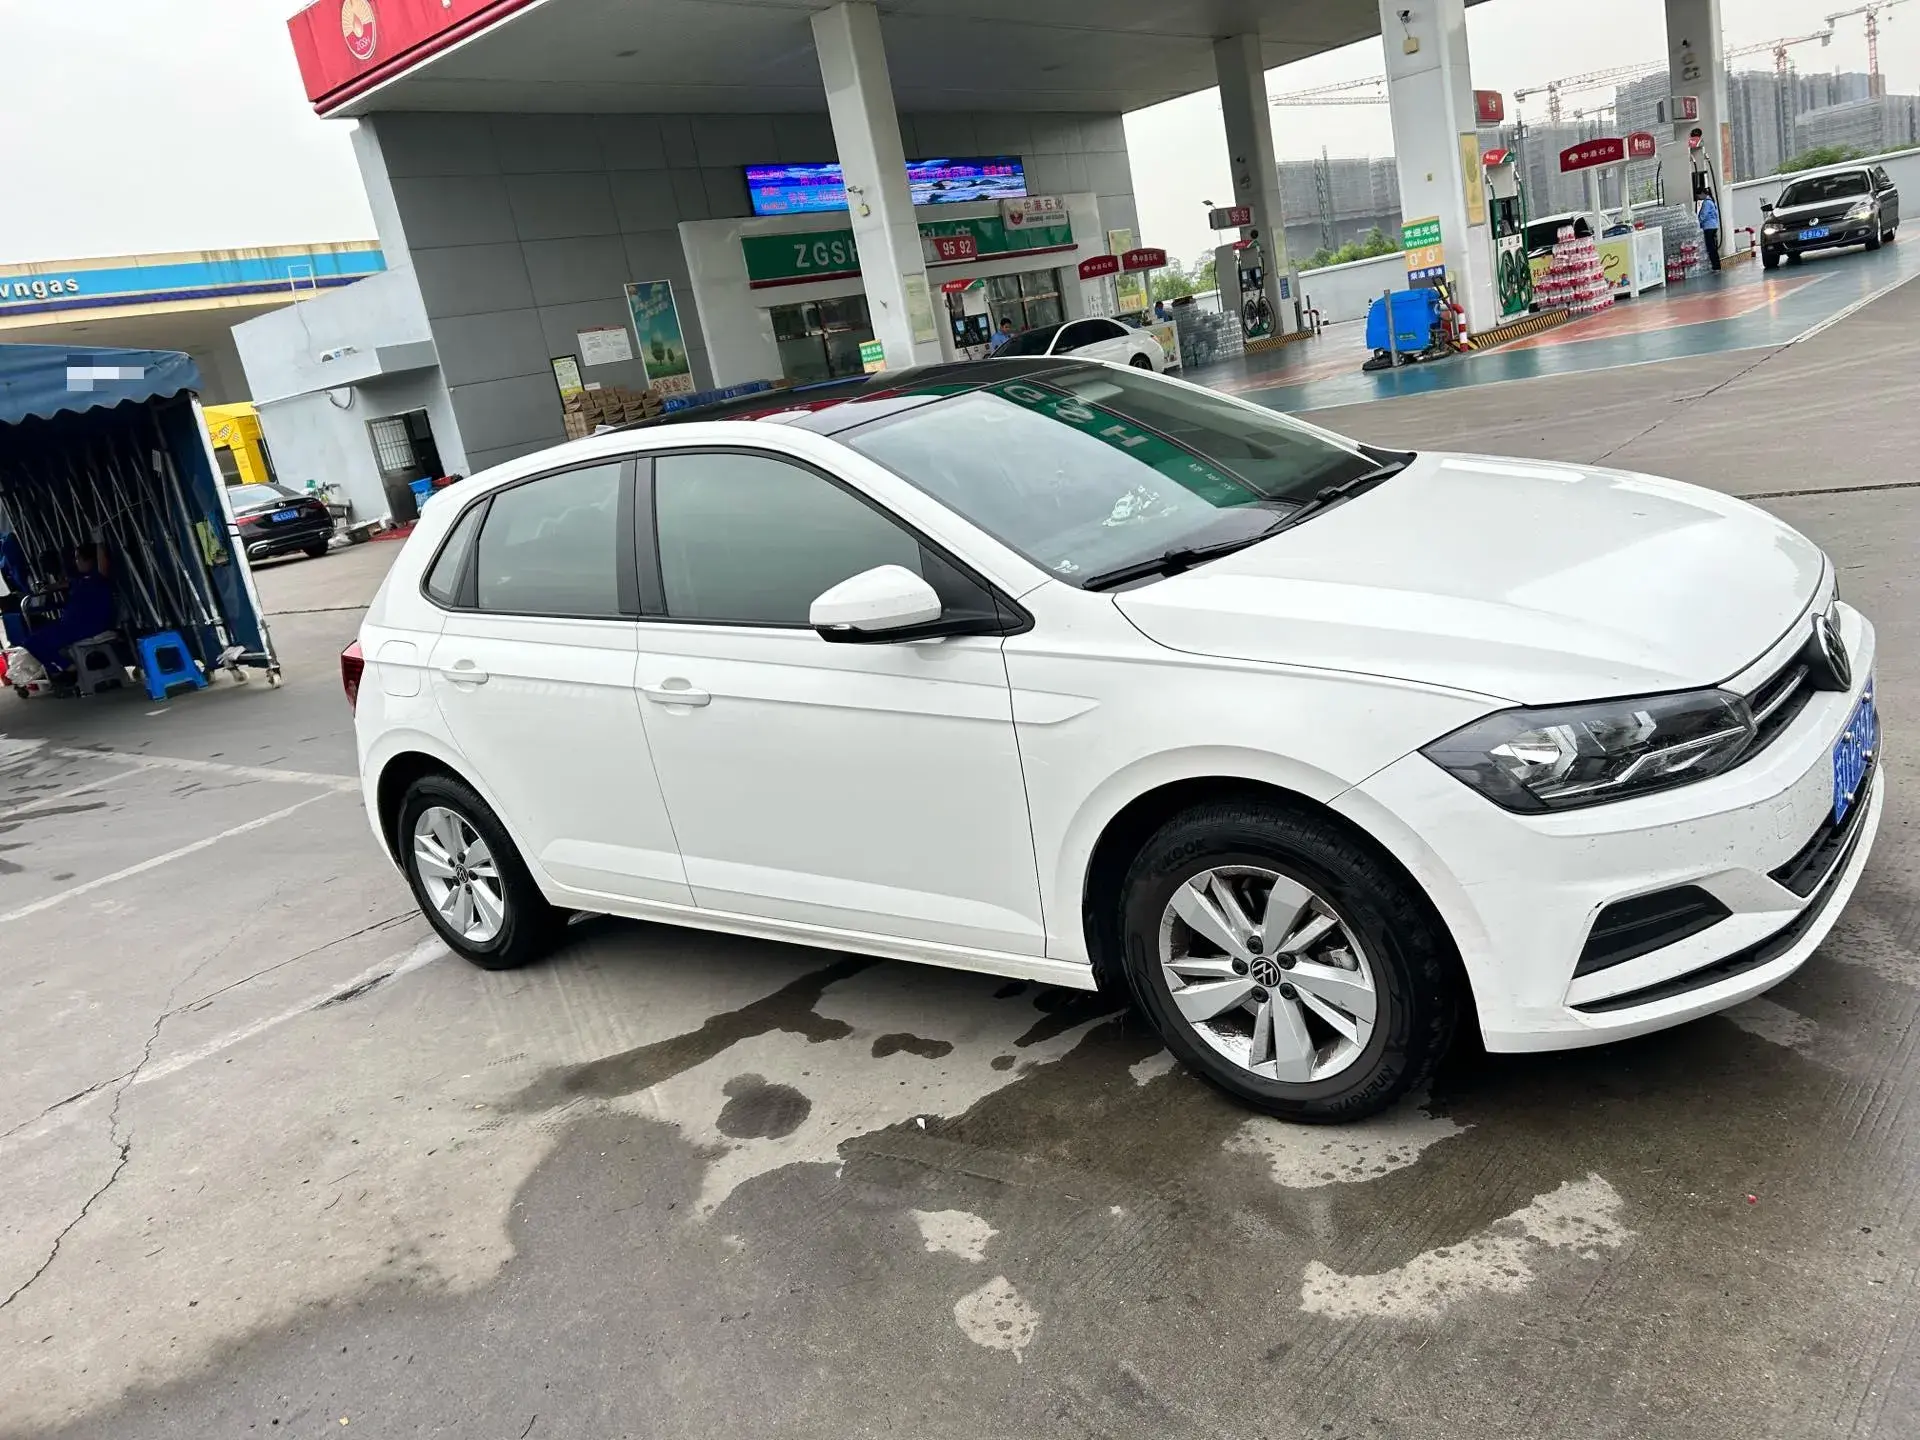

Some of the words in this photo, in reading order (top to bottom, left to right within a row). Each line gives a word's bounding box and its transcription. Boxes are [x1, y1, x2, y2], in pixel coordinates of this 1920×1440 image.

[1581, 146, 1615, 160] 中港石化
[1024, 198, 1063, 213] 中港石化
[942, 241, 955, 256] 95
[959, 241, 972, 255] 92
[1405, 236, 1440, 248] Welcome
